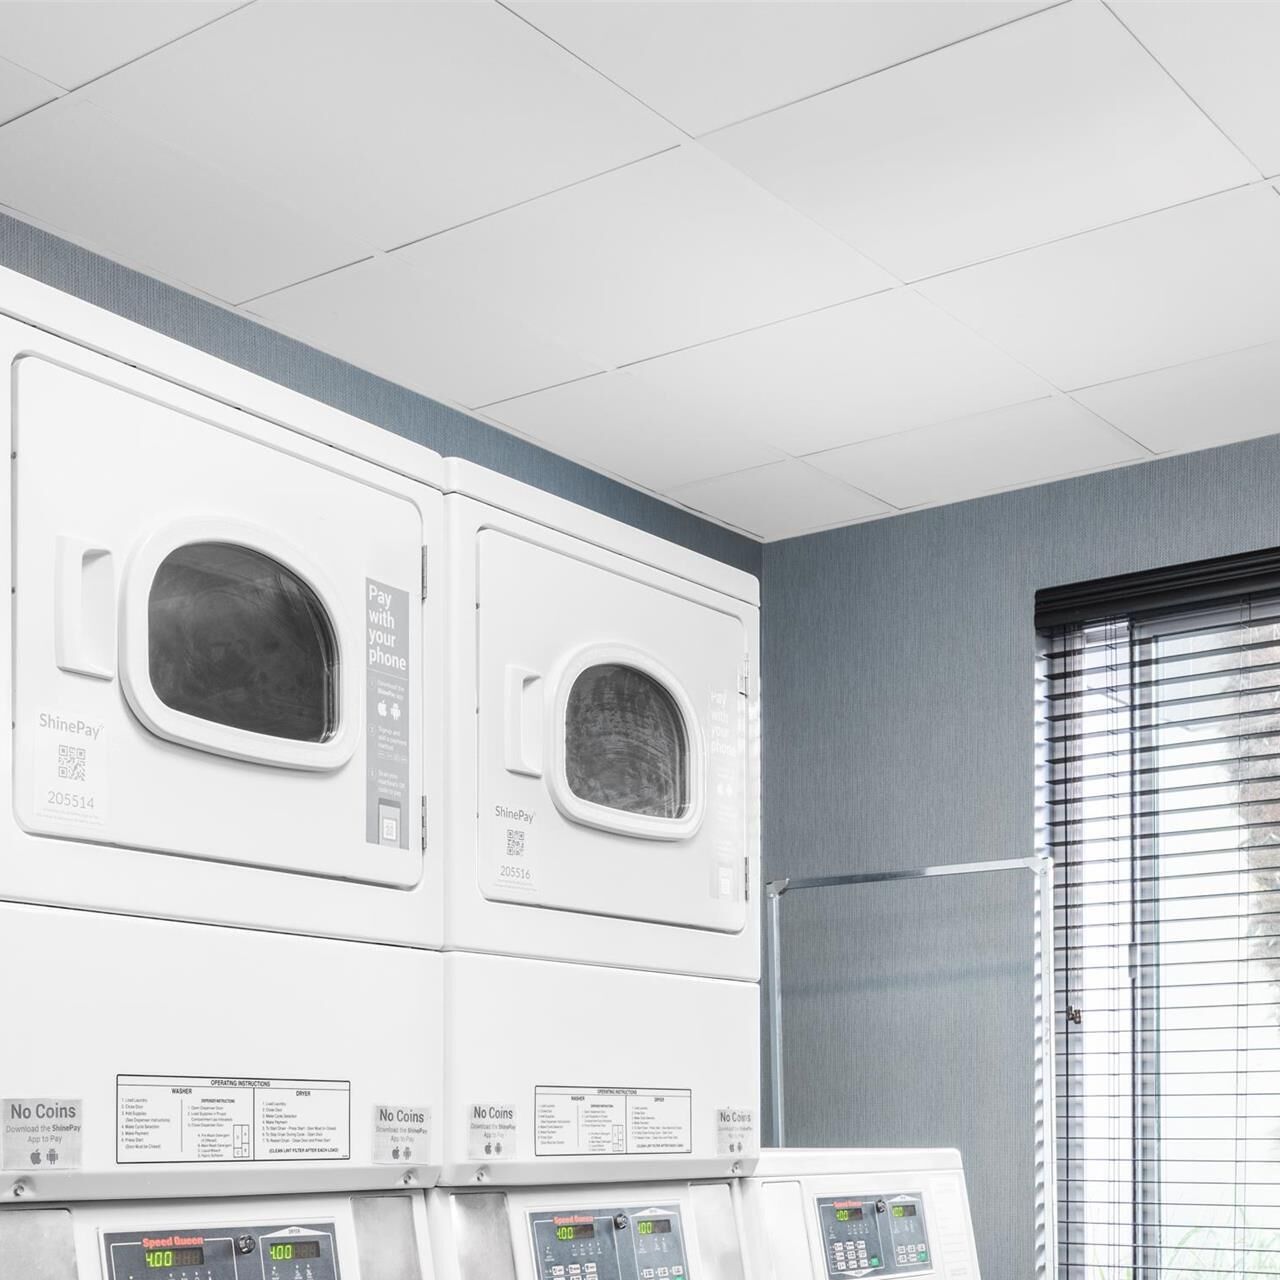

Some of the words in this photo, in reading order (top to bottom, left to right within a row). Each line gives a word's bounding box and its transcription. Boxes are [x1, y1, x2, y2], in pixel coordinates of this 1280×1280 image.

[369, 584, 391, 610] Pay
[369, 608, 394, 629] with
[369, 628, 396, 647] your
[369, 646, 406, 670] phone
[39, 713, 100, 740] ShinePay
[47, 790, 95, 809] 205514
[495, 805, 534, 824] ShinePay
[500, 865, 531, 880] 205516
[11, 1103, 31, 1119] No
[36, 1102, 76, 1119] Coins
[380, 1108, 394, 1122] No
[396, 1109, 424, 1123] Coins
[473, 1106, 486, 1119] No
[488, 1106, 513, 1120] Coins
[720, 1111, 730, 1123] No
[6, 1124, 39, 1133] Download
[40, 1124, 51, 1132] the
[52, 1124, 81, 1133] ShinePay
[27, 1136, 41, 1144] App
[50, 1135, 62, 1143] Pay
[143, 1238, 173, 1248] Speed
[174, 1237, 205, 1246] Queen
